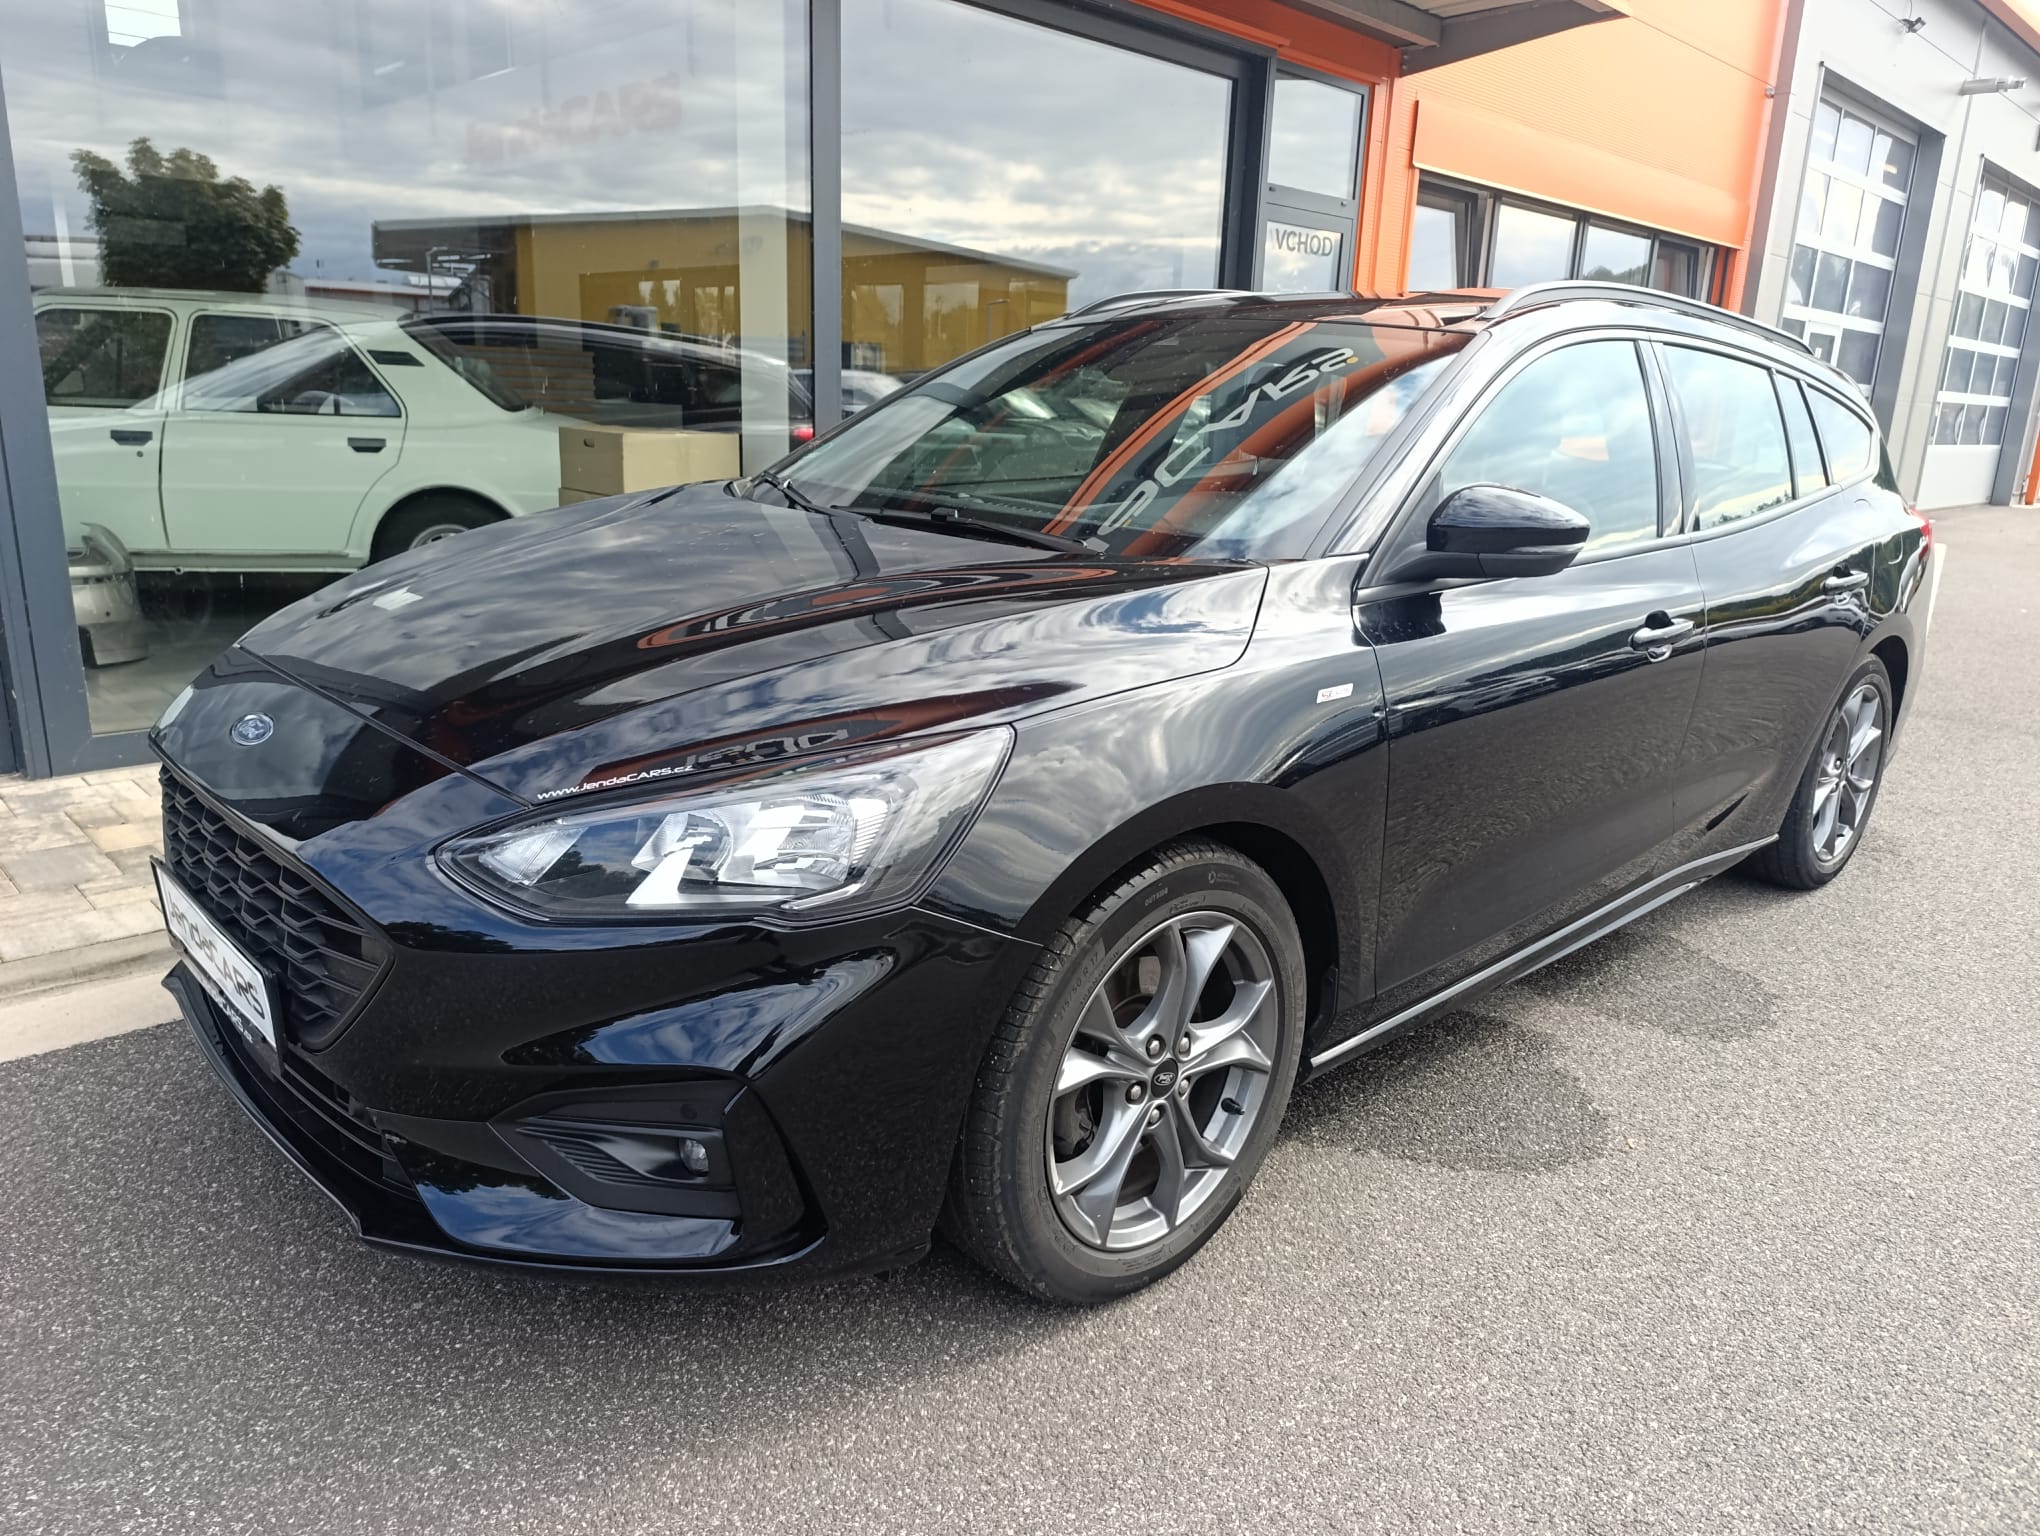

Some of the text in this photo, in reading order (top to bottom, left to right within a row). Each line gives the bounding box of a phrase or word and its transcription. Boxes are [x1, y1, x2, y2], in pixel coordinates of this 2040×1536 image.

[1275, 228, 1333, 257] VCHOD
[537, 765, 695, 800] www.JendaCARS.cz
[168, 890, 266, 1020] JendaCARS
